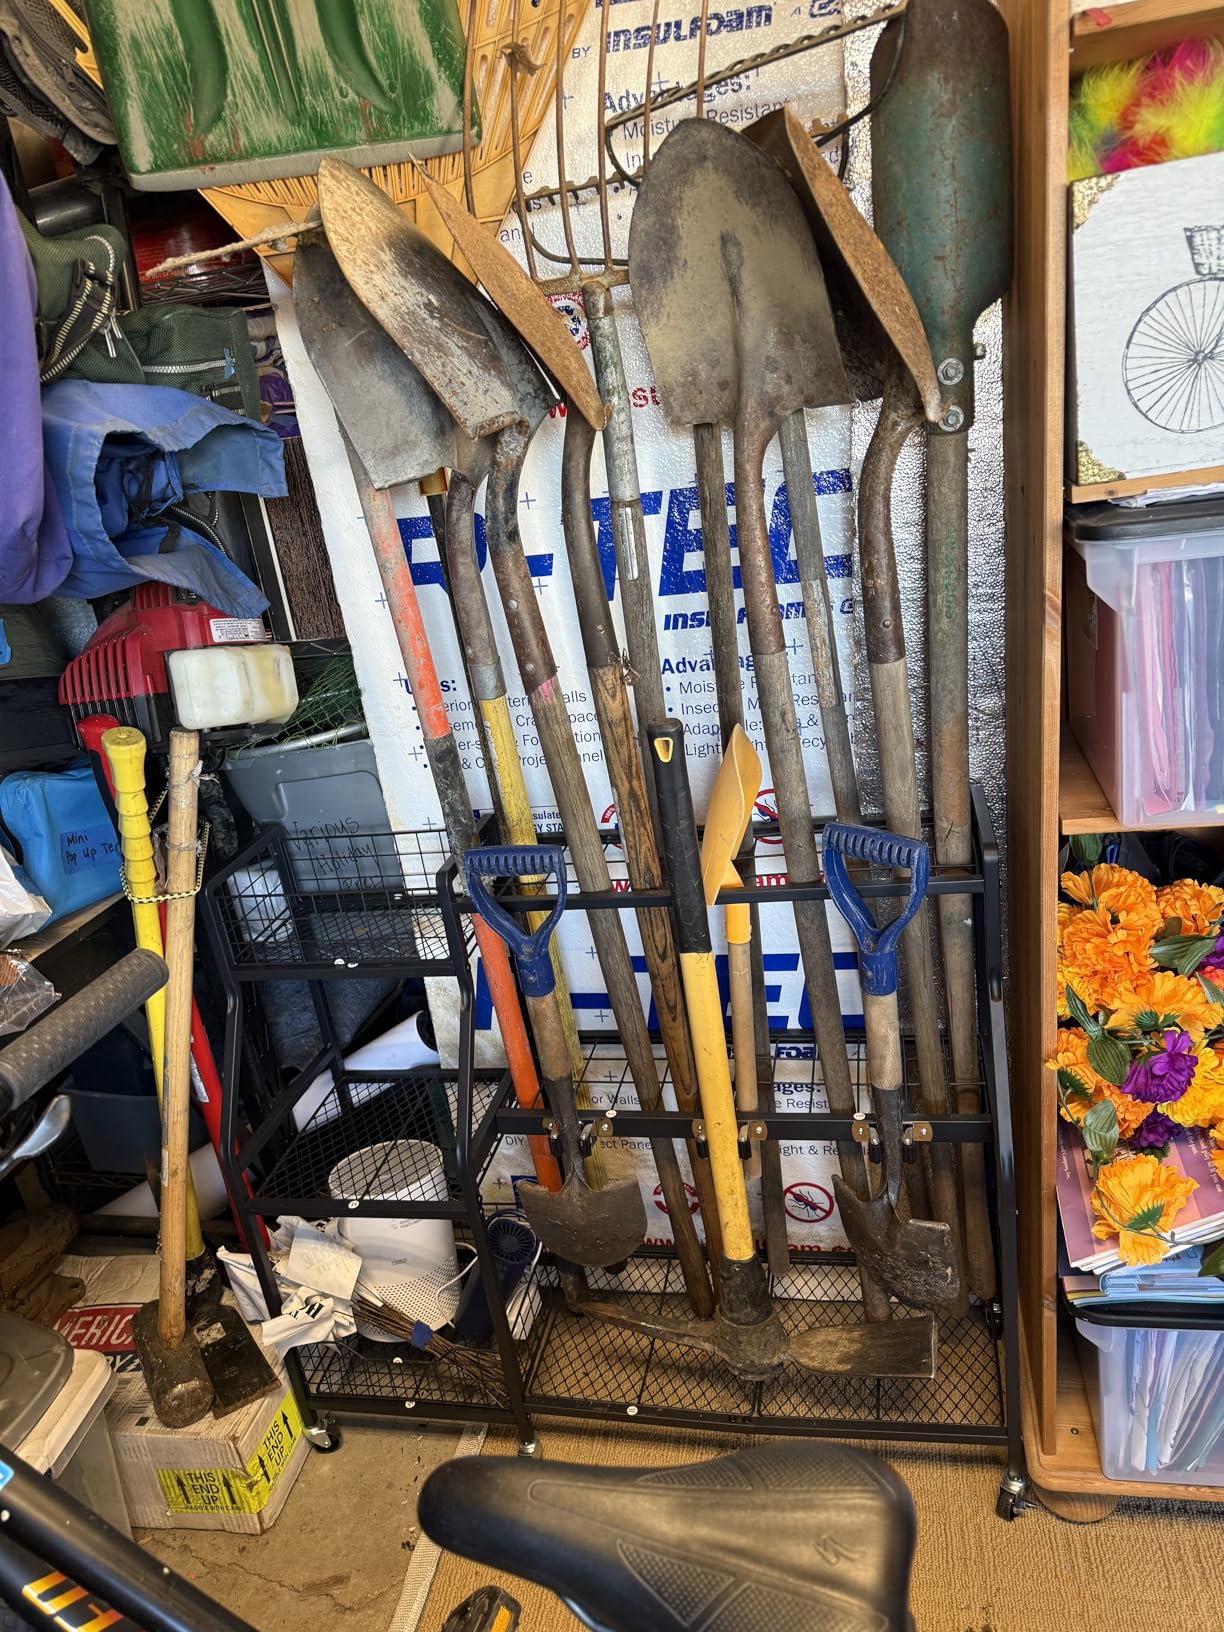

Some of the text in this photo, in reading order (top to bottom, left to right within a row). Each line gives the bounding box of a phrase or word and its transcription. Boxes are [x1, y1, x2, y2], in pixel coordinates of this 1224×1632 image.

[571, 46, 591, 59] BY
[561, 691, 587, 704] alls
[681, 703, 720, 716] Insec
[67, 830, 88, 847] Mini
[65, 851, 77, 866] Pop
[83, 848, 97, 861] Up
[607, 1094, 640, 1105] Walls
[787, 1098, 829, 1109] Resist
[505, 1135, 525, 1146] DIY
[621, 1140, 653, 1150] Pane
[263, 1420, 280, 1450] THIS
[267, 1432, 284, 1462] END
[274, 1446, 285, 1467] UP
[187, 1472, 216, 1484] THIS
[192, 1484, 220, 1494] END
[202, 1495, 219, 1505] UP
